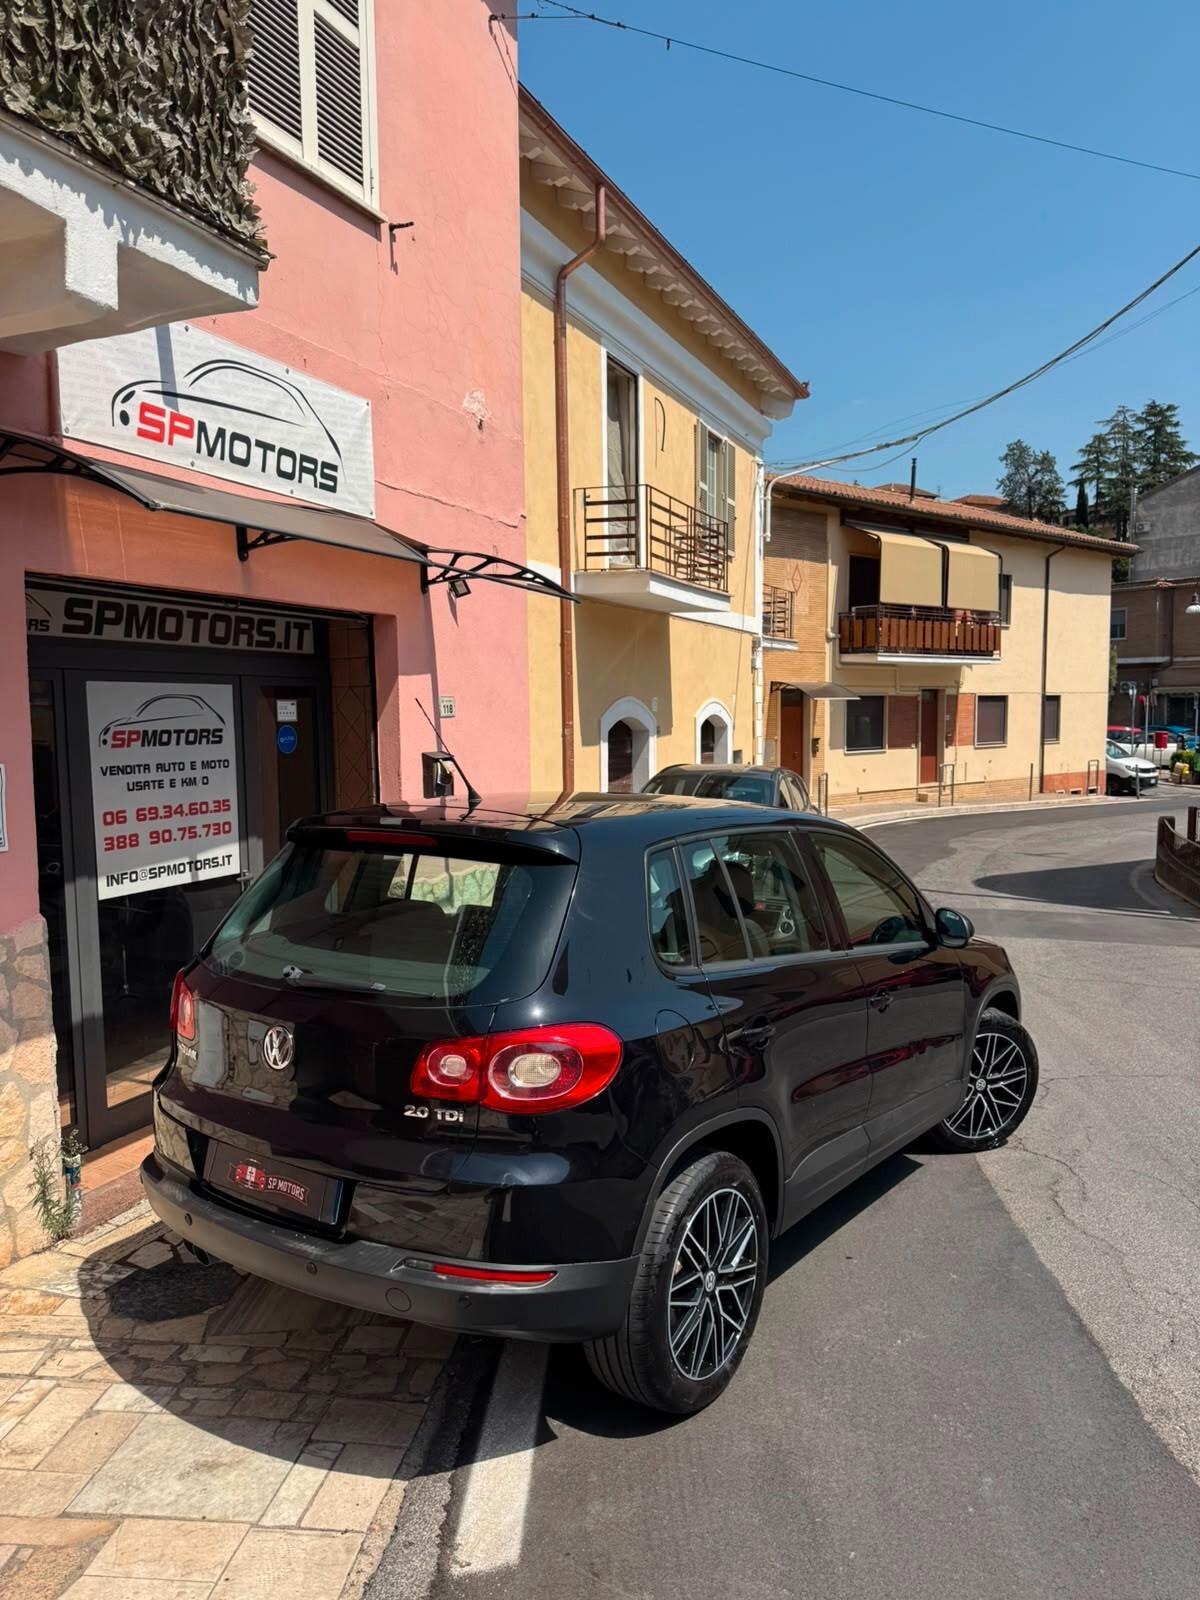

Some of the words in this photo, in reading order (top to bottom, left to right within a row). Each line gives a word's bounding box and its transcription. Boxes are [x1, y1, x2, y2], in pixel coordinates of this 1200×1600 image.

[137, 401, 339, 494] SPMOTORS
[62, 597, 311, 651] SPMOTORS.IT
[111, 728, 224, 748] SPMOTORS
[100, 763, 151, 777] VENDITA
[155, 761, 185, 773] AUTO
[190, 760, 197, 771] E
[201, 759, 230, 770] MOTO
[126, 779, 164, 792] USATE
[169, 778, 176, 788] E
[181, 777, 197, 787] KM
[103, 809, 127, 826] 06
[136, 799, 231, 822] 69.34.60.35
[104, 833, 140, 852] 388
[149, 821, 232, 845] 90.75.730
[106, 854, 233, 887] INFO@SPMOTORS.IT
[267, 1177, 278, 1190] SP
[277, 1179, 305, 1201] MOTORS
